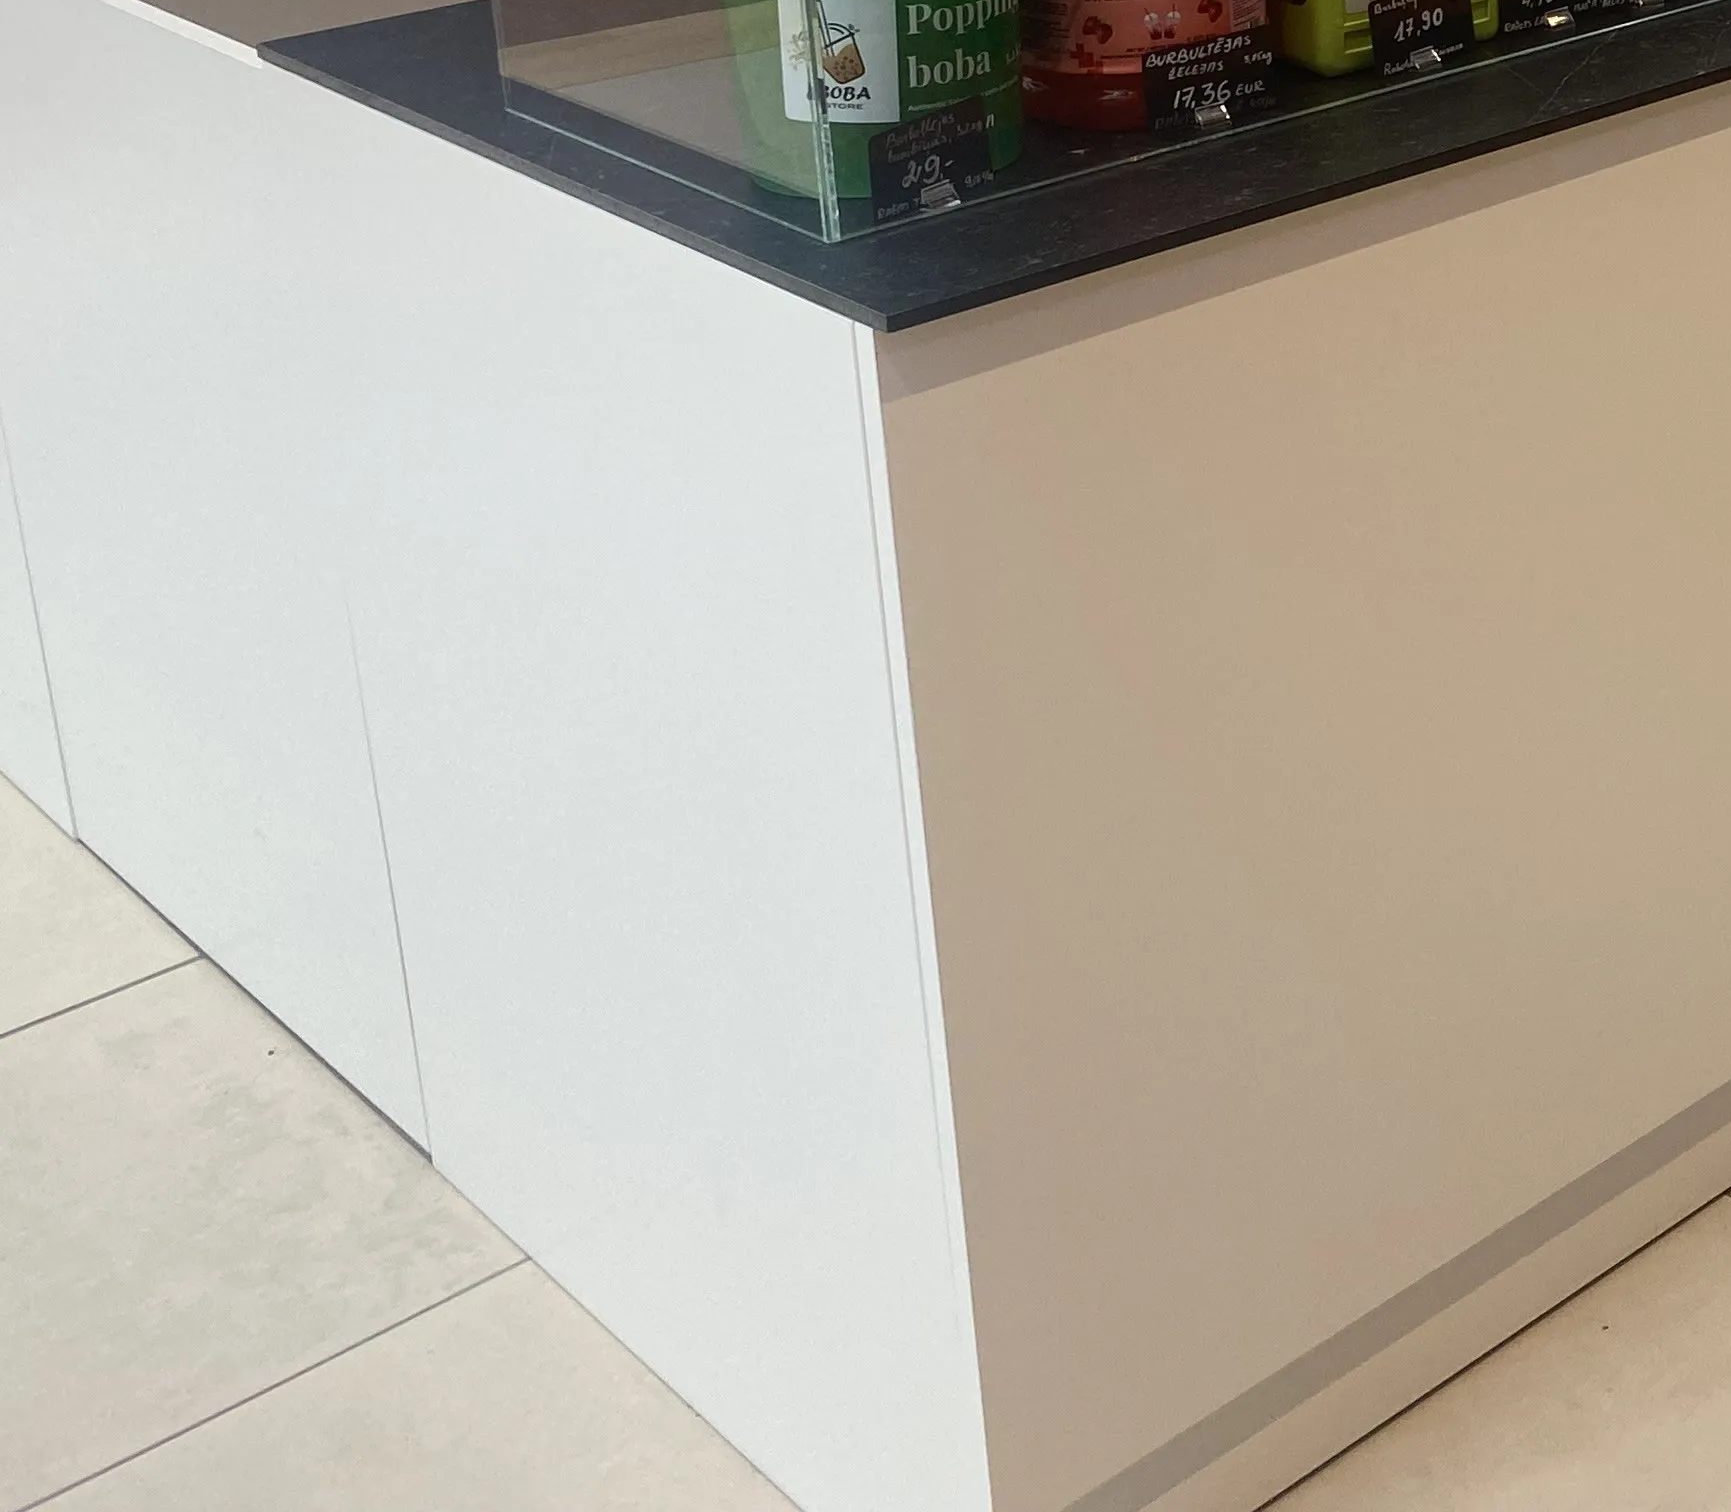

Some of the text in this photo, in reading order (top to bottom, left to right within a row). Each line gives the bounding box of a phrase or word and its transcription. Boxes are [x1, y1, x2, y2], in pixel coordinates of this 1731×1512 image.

[1394, 8, 1443, 42] 17,90
[907, 47, 991, 88] boba
[1173, 80, 1266, 109] 17,36 EUR
